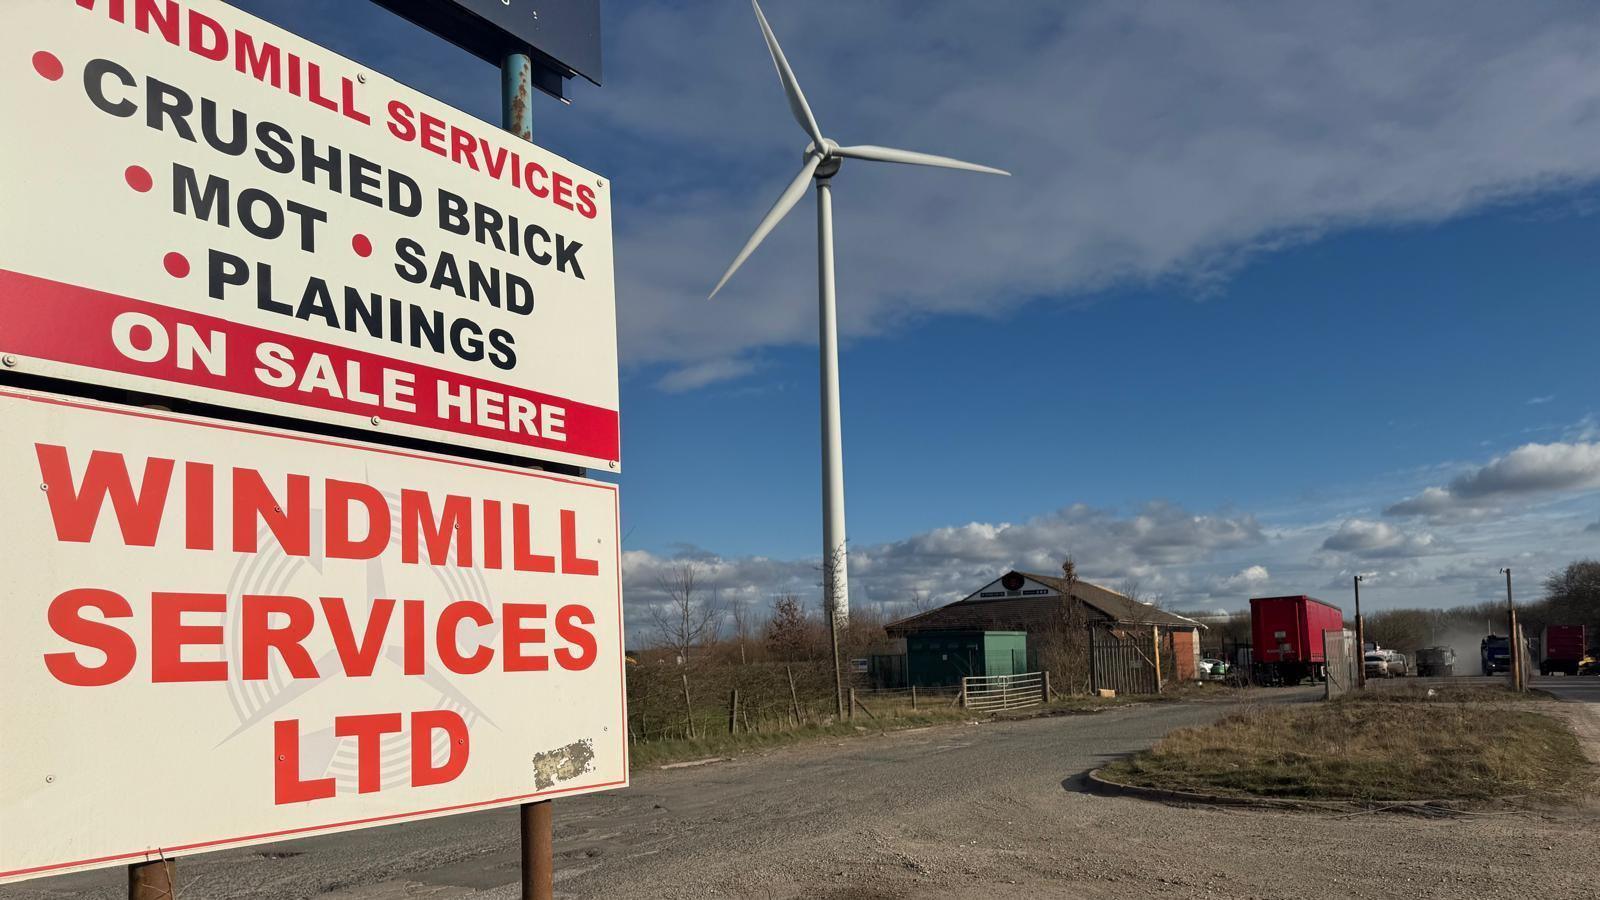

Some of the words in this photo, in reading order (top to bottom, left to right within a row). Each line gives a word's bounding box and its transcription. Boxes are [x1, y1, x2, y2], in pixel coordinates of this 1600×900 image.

[75, 0, 371, 125] INDMILL
[387, 100, 598, 220] SERVICES
[83, 58, 423, 218] CRUSHED
[437, 188, 586, 281] BRICK
[172, 162, 328, 254] MOT
[394, 237, 535, 316] SAND
[208, 248, 517, 371] PLANINGS
[111, 311, 227, 377] ON
[254, 342, 417, 413] SALE
[436, 379, 568, 442] HERE
[34, 442, 600, 577] WINDMILL
[43, 588, 599, 687] SERVICES
[273, 709, 471, 806] LTD
